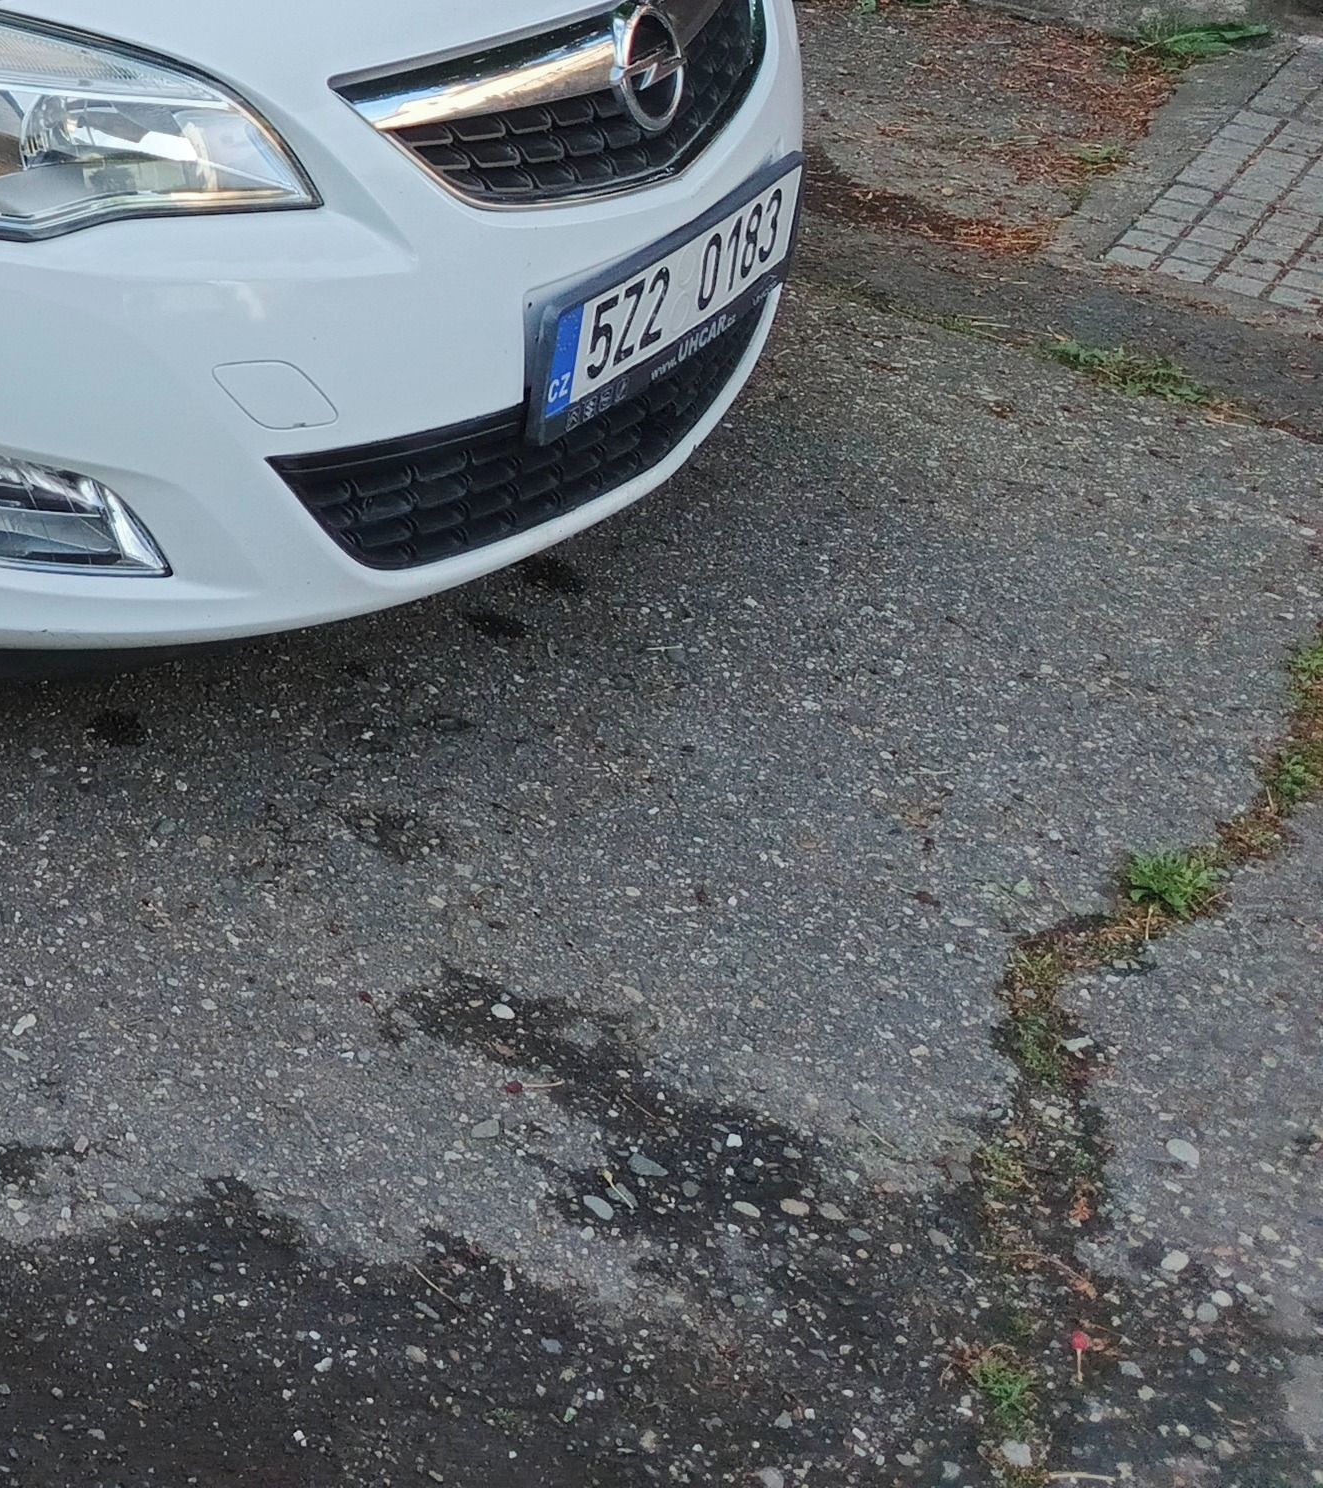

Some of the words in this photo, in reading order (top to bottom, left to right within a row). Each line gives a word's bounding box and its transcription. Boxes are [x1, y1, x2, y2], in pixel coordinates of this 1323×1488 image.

[585, 266, 671, 380] 5Z2
[697, 188, 783, 311] 0183
[547, 372, 572, 404] CZ
